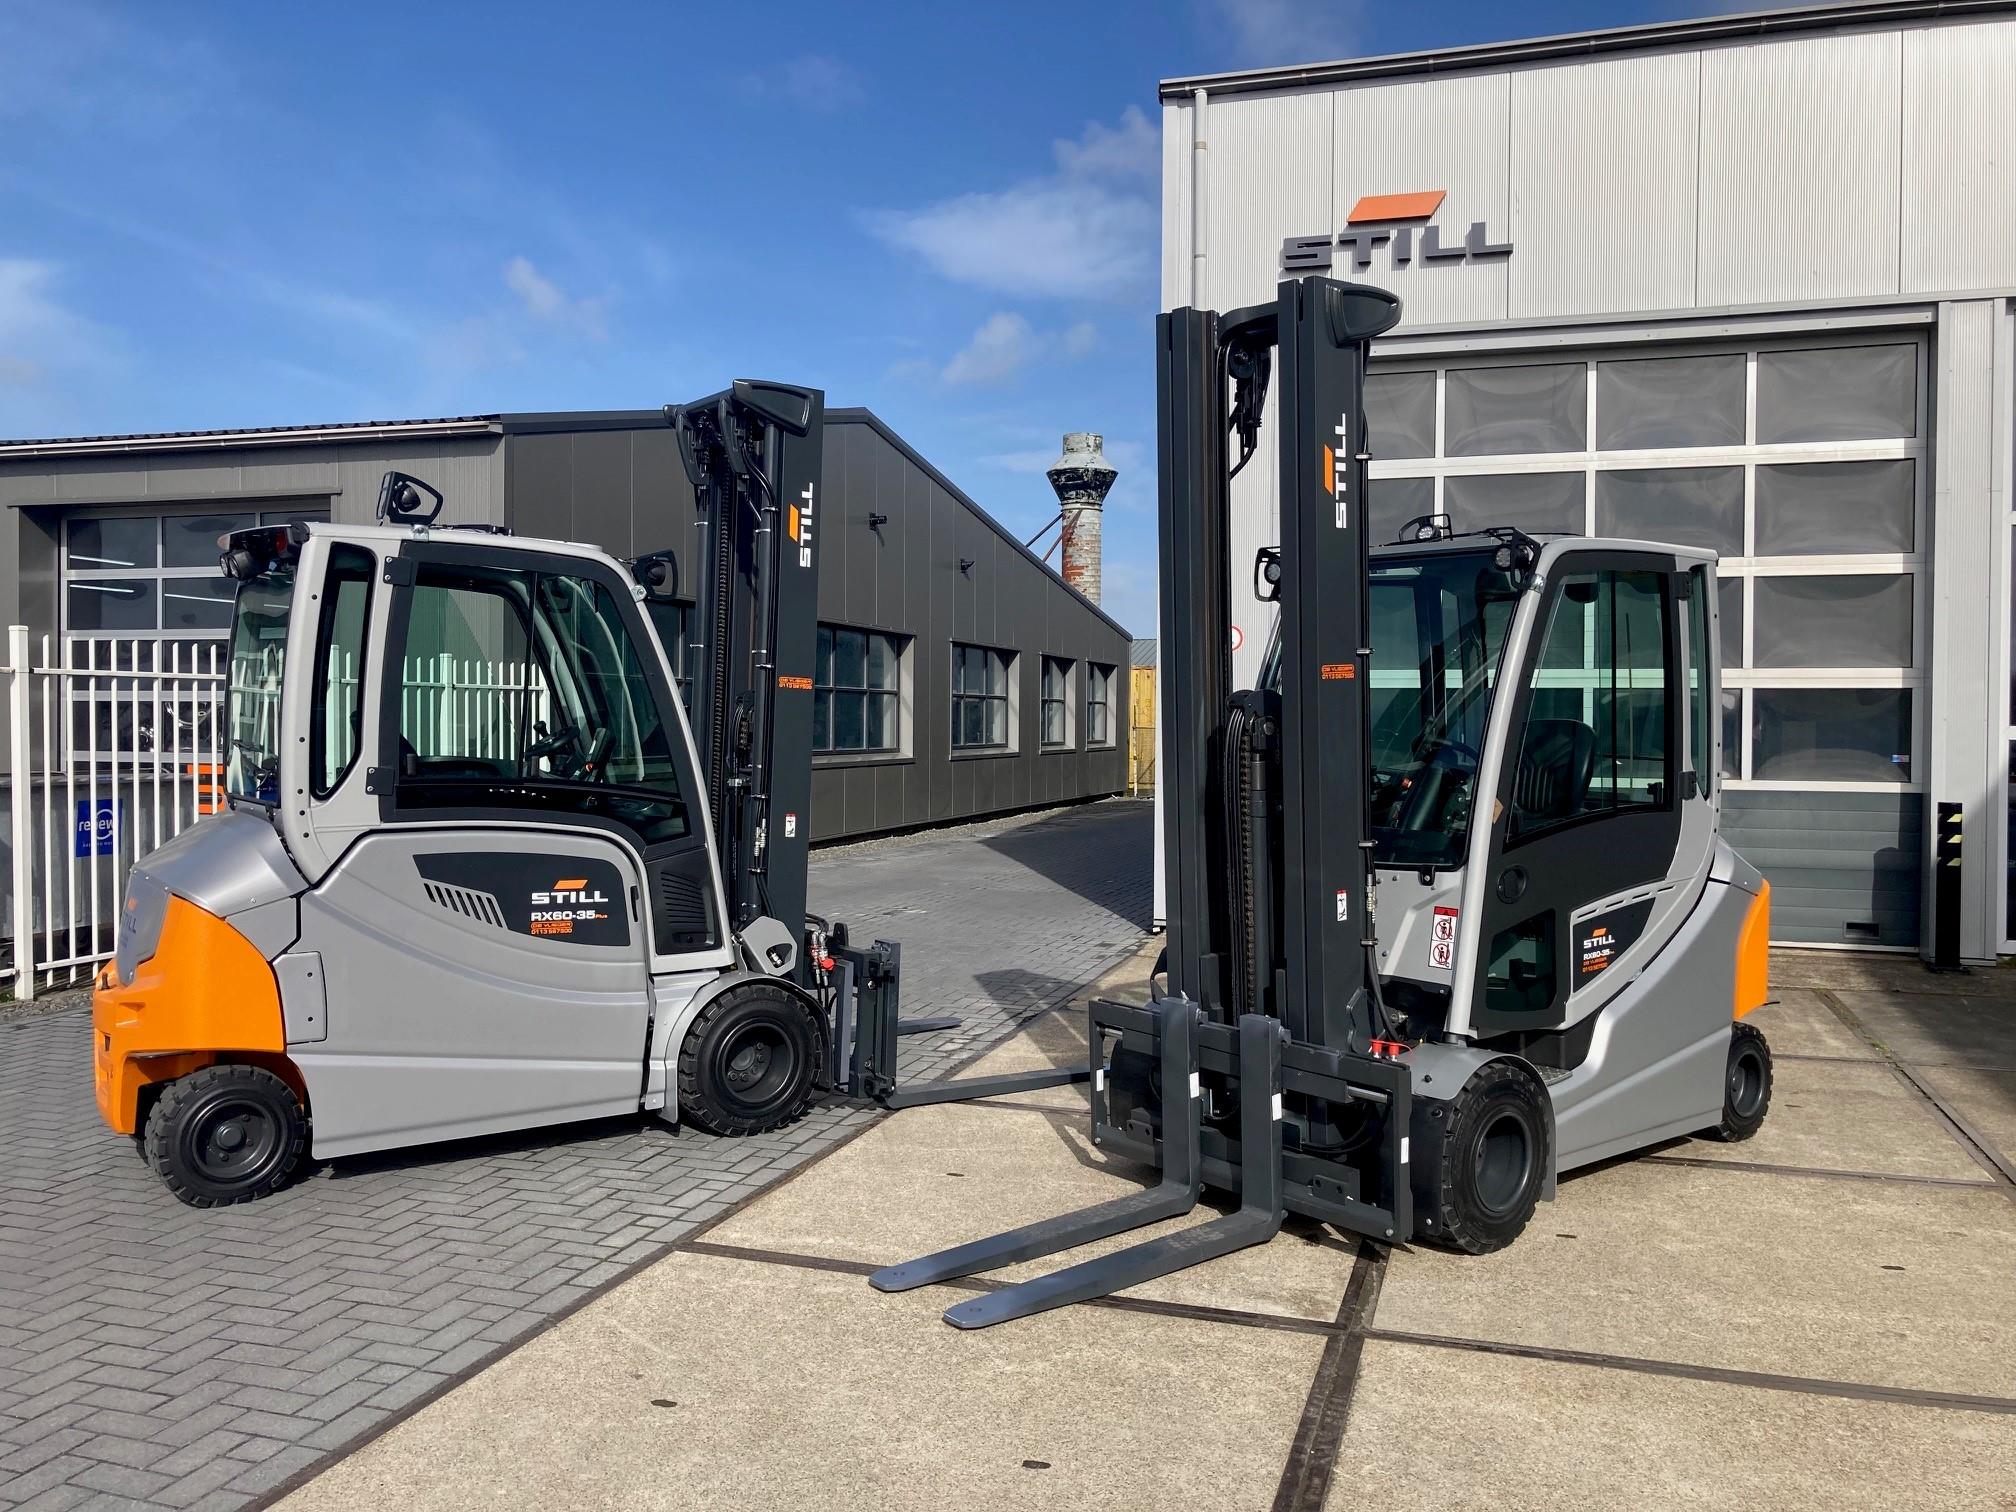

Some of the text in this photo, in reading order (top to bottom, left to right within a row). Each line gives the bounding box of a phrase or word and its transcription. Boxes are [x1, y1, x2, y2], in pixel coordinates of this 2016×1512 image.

[1283, 221, 1514, 270] STILL
[1334, 413, 1347, 529] STILL
[799, 482, 814, 568] STILL
[531, 890, 609, 905] STILL
[530, 909, 596, 922] RX60-35
[1583, 934, 1616, 949] STILL
